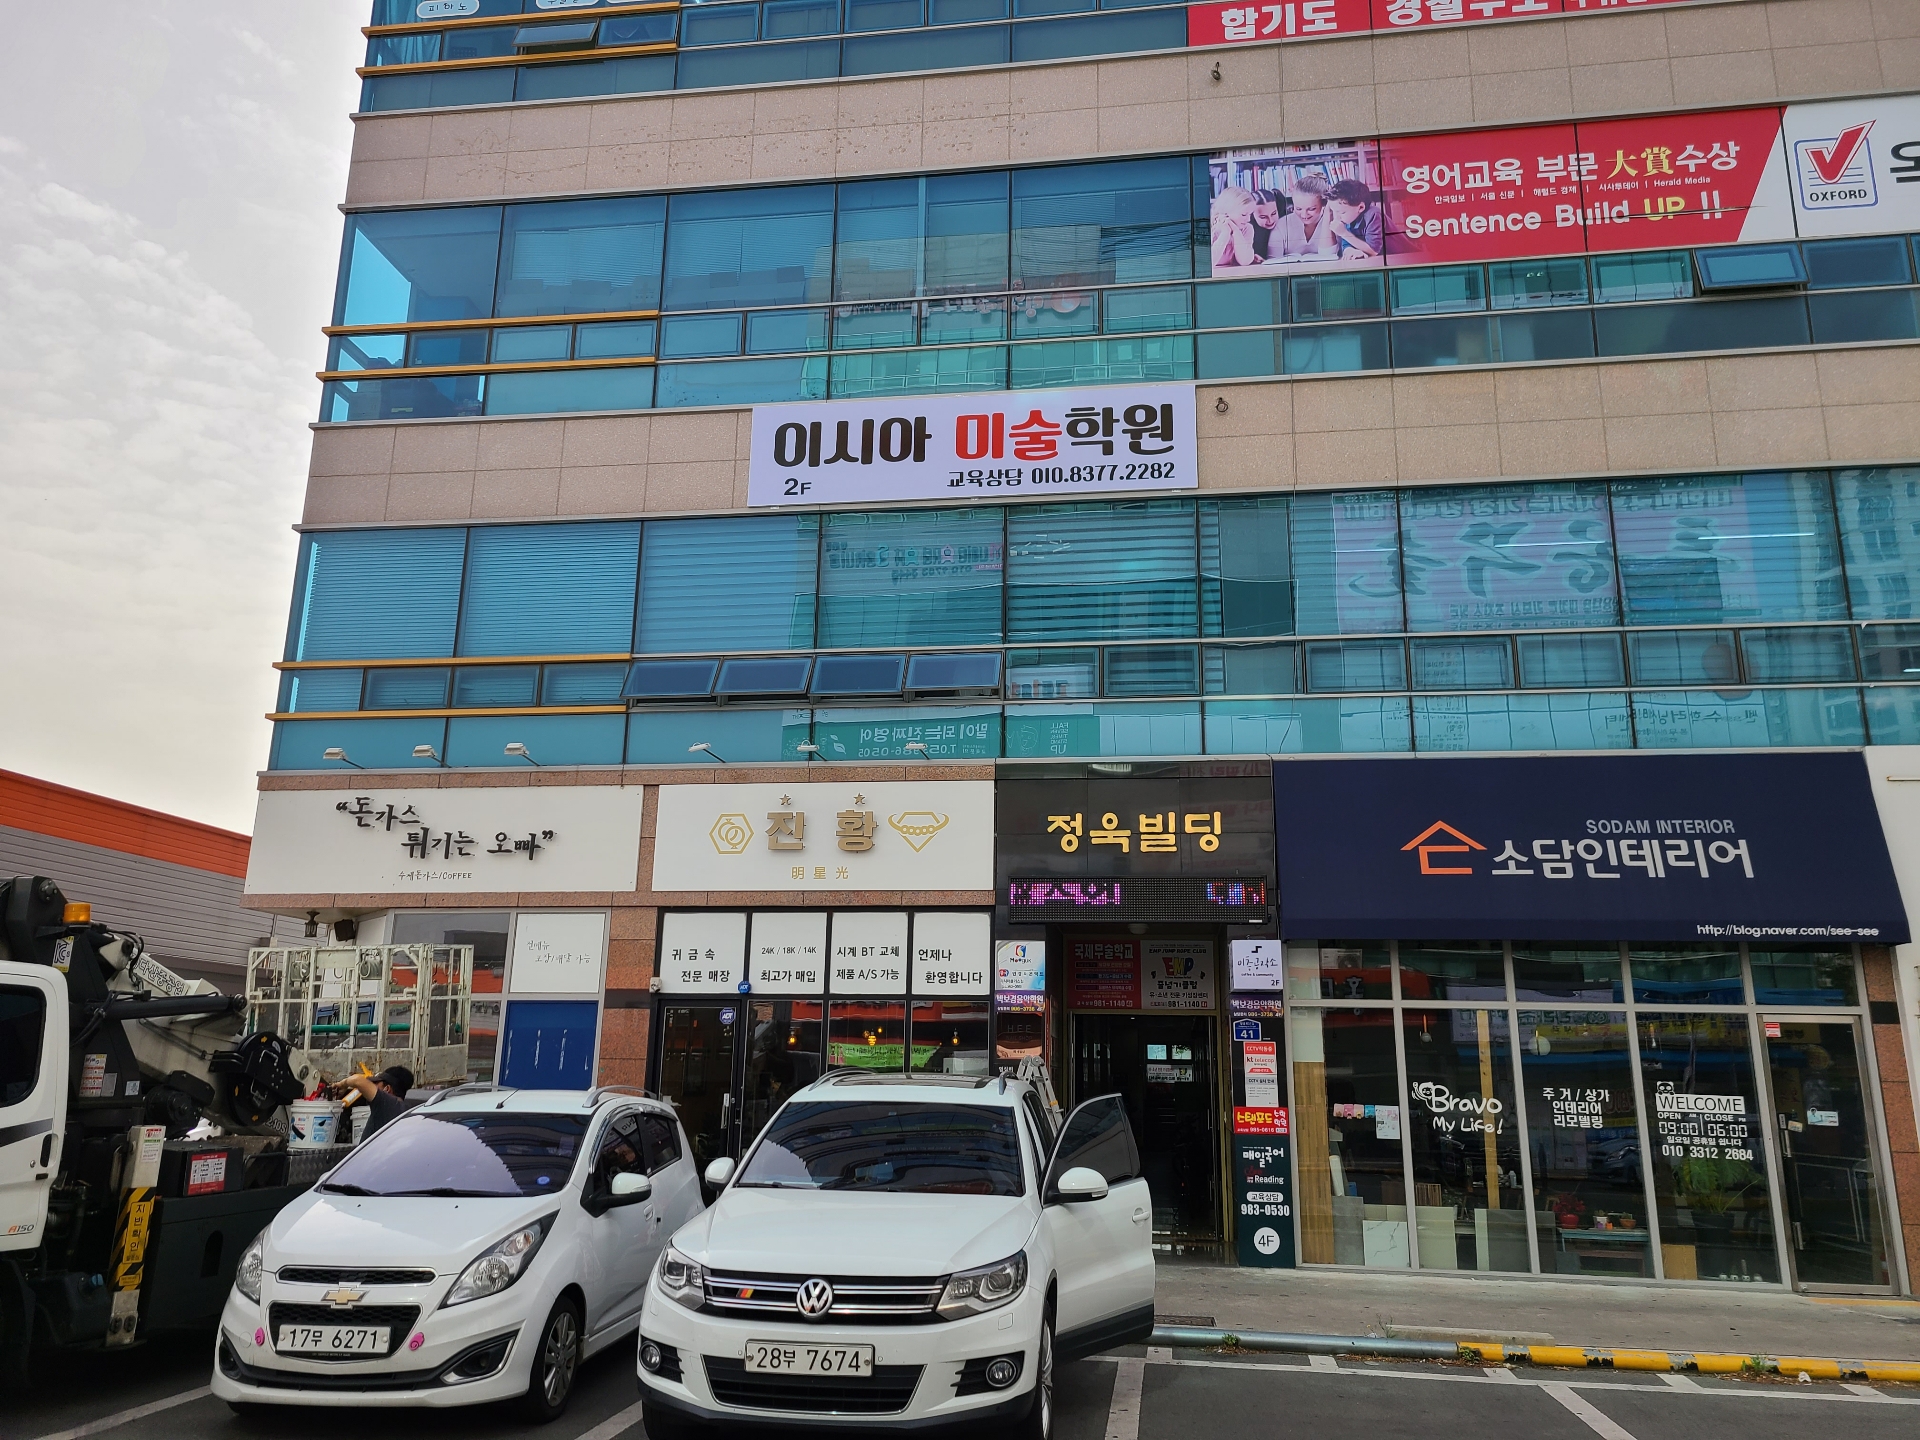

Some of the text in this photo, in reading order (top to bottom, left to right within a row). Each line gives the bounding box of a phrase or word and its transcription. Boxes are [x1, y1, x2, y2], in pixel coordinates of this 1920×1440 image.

[1221, 0, 1337, 40] 합기도
[1402, 158, 1523, 193] 영어교육
[1537, 153, 1599, 179] 부문
[1653, 178, 1681, 187] Herald
[1685, 175, 1711, 185] Media
[1809, 189, 1867, 202] OXFORD
[1405, 212, 1541, 239] Sentence
[1556, 201, 1629, 227] Build
[1643, 196, 1686, 221] UP
[955, 403, 1174, 461] 미술학원
[783, 462, 1175, 496] 2F 교육상담 010.8377.2282
[1047, 811, 1223, 853] 정욱빌딩
[1586, 819, 1735, 835] SODAM INTERIOR
[402, 827, 478, 859] 튀기는
[1491, 838, 1754, 879] 소담인테리어
[1696, 923, 1879, 938] http://blog.naver.com/see-see
[761, 946, 817, 956] 24K 18K 14K
[837, 946, 900, 957] 시계 BT 교체
[918, 948, 952, 962] 언제나
[1162, 956, 1195, 976] EMP
[681, 970, 730, 983] 전문 매장
[760, 970, 816, 983] 최고가 매입
[836, 968, 900, 981] 제품 A/S 가능
[925, 971, 983, 985] 환영합니다
[1240, 1030, 1254, 1039] 41
[1430, 1085, 1503, 1114] Bravo
[1585, 1088, 1610, 1102] 상가
[1553, 1101, 1602, 1115] 인테리어
[1658, 1096, 1744, 1112] WELCOME
[1554, 1115, 1603, 1128] 리모델링
[1658, 1112, 1681, 1120] OPEN
[1704, 1114, 1734, 1122] CLOSE
[1433, 1117, 1456, 1132] My
[1658, 1121, 1748, 1137] 09:00 06:00
[1667, 1136, 1691, 1144] 일요일
[1692, 1137, 1716, 1145] 공휴일
[1242, 1146, 1284, 1168] 매일국어
[1662, 1145, 1754, 1161] 010 3312 2684
[1254, 1175, 1284, 1185] Reading
[1250, 1193, 1279, 1202] 교육상담
[8, 1224, 34, 1233] A150
[1257, 1235, 1275, 1247] 4F
[289, 1328, 378, 1350] 17무 6271
[757, 1347, 861, 1372] 28부 7674
